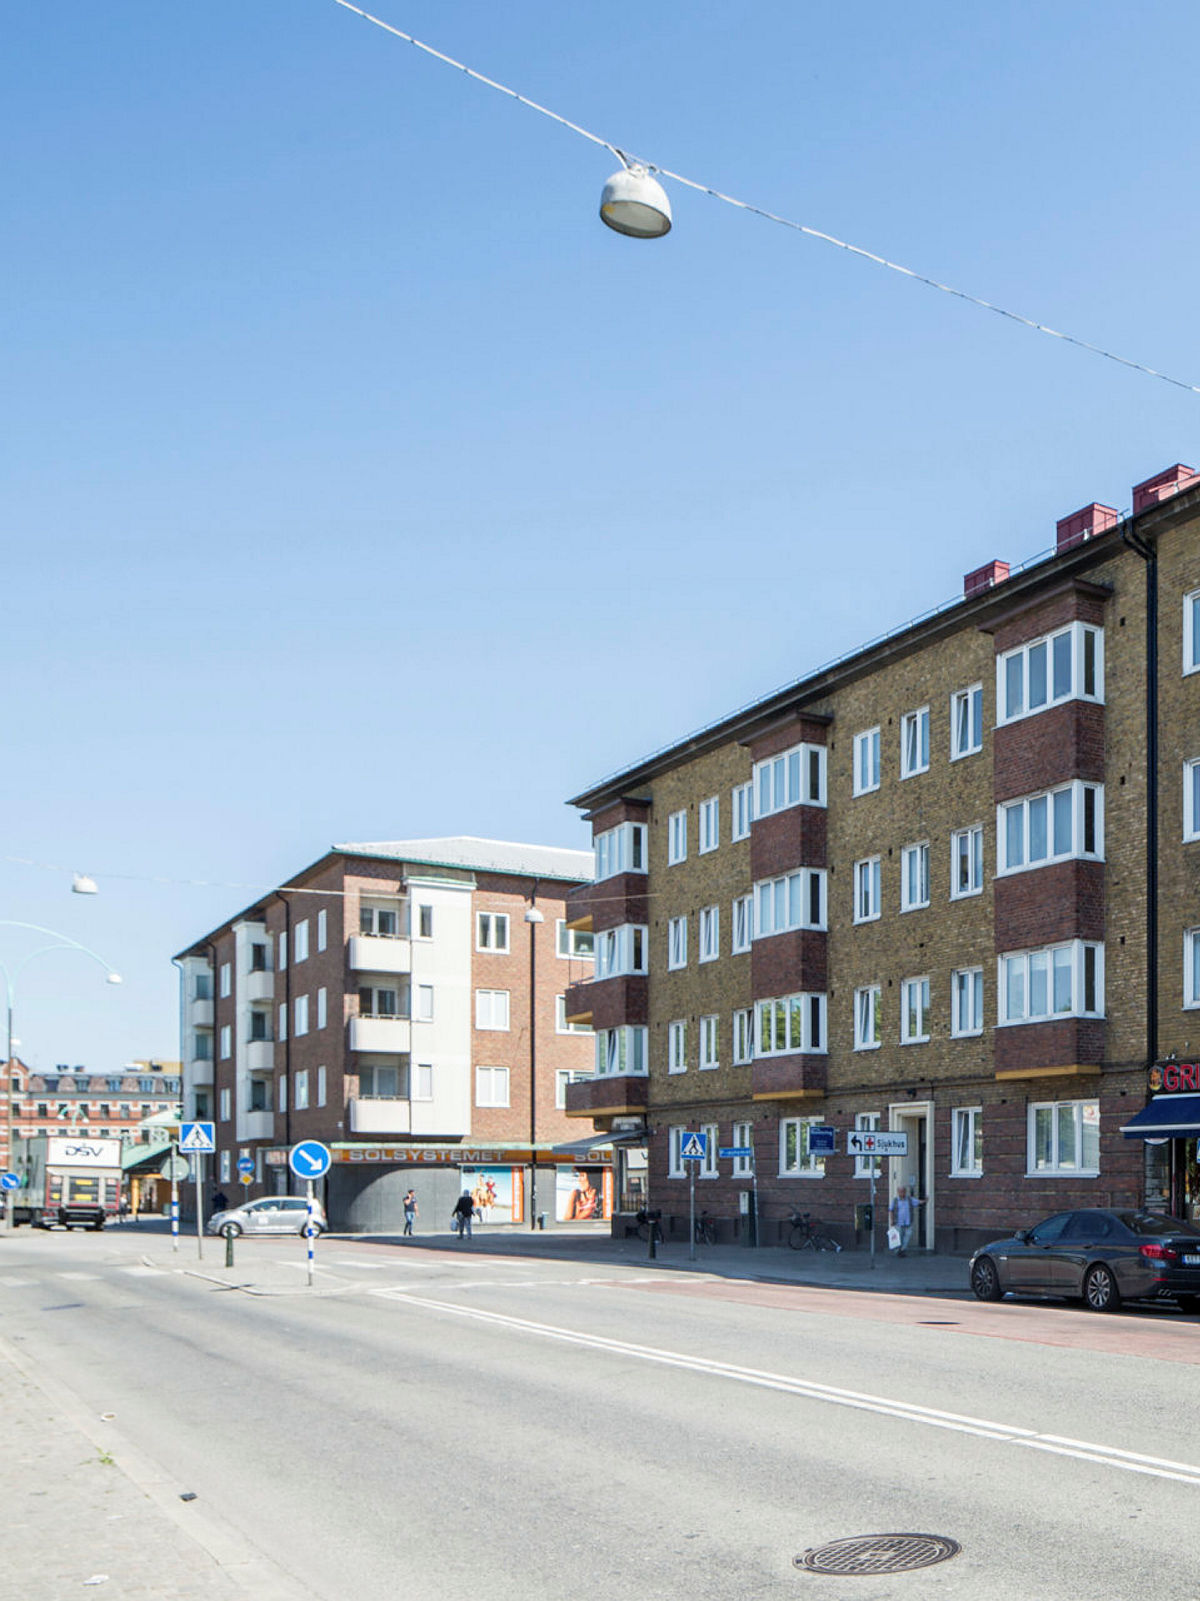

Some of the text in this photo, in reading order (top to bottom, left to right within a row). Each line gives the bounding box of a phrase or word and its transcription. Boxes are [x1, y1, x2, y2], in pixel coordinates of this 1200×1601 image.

[877, 1138, 905, 1150] Sjukhus
[65, 1145, 104, 1157] DSV
[349, 1149, 505, 1162] SOLSYSTEMET
